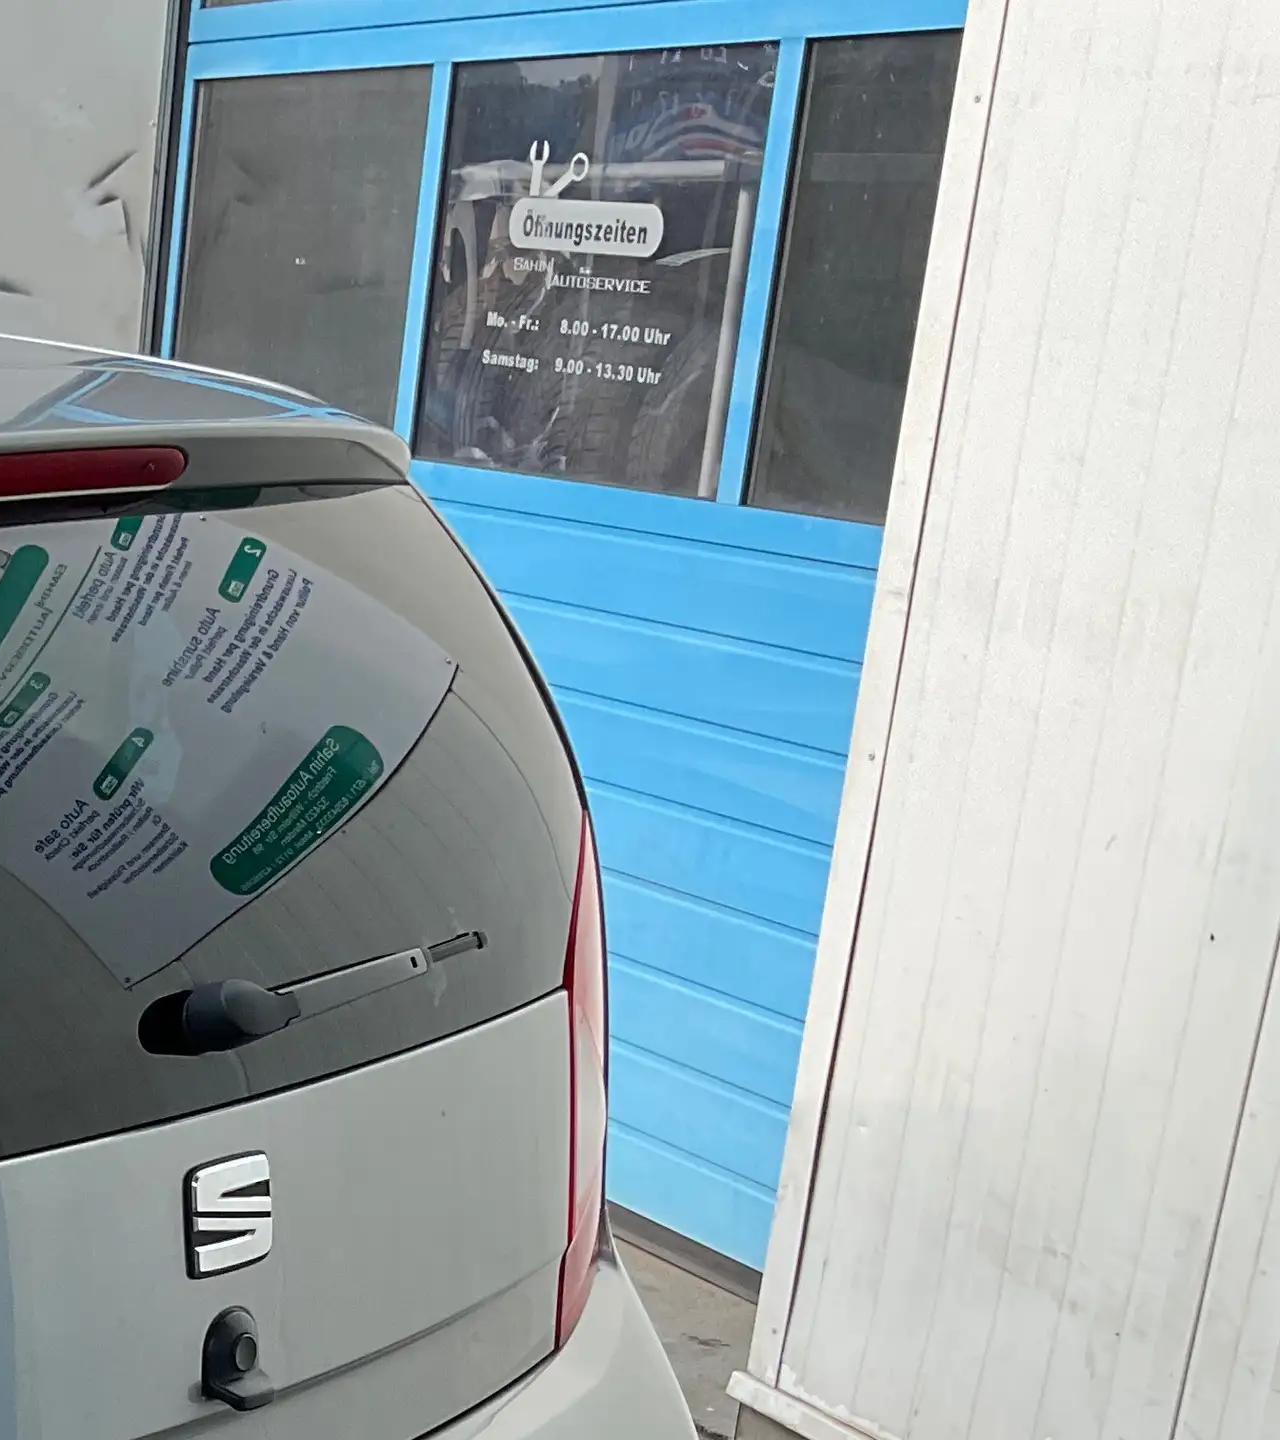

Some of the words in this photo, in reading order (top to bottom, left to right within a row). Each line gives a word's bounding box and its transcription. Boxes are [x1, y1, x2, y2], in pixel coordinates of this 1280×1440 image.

[514, 256, 551, 273] SAHIN
[550, 275, 651, 293] AUTOSERVICE
[560, 319, 589, 337] 8.00
[601, 323, 640, 342] 17.00
[644, 328, 672, 346] Uhr
[481, 349, 539, 373] Samstag:
[555, 358, 584, 375] 9.00
[595, 362, 634, 381] 13.30
[637, 367, 662, 385] Uhr
